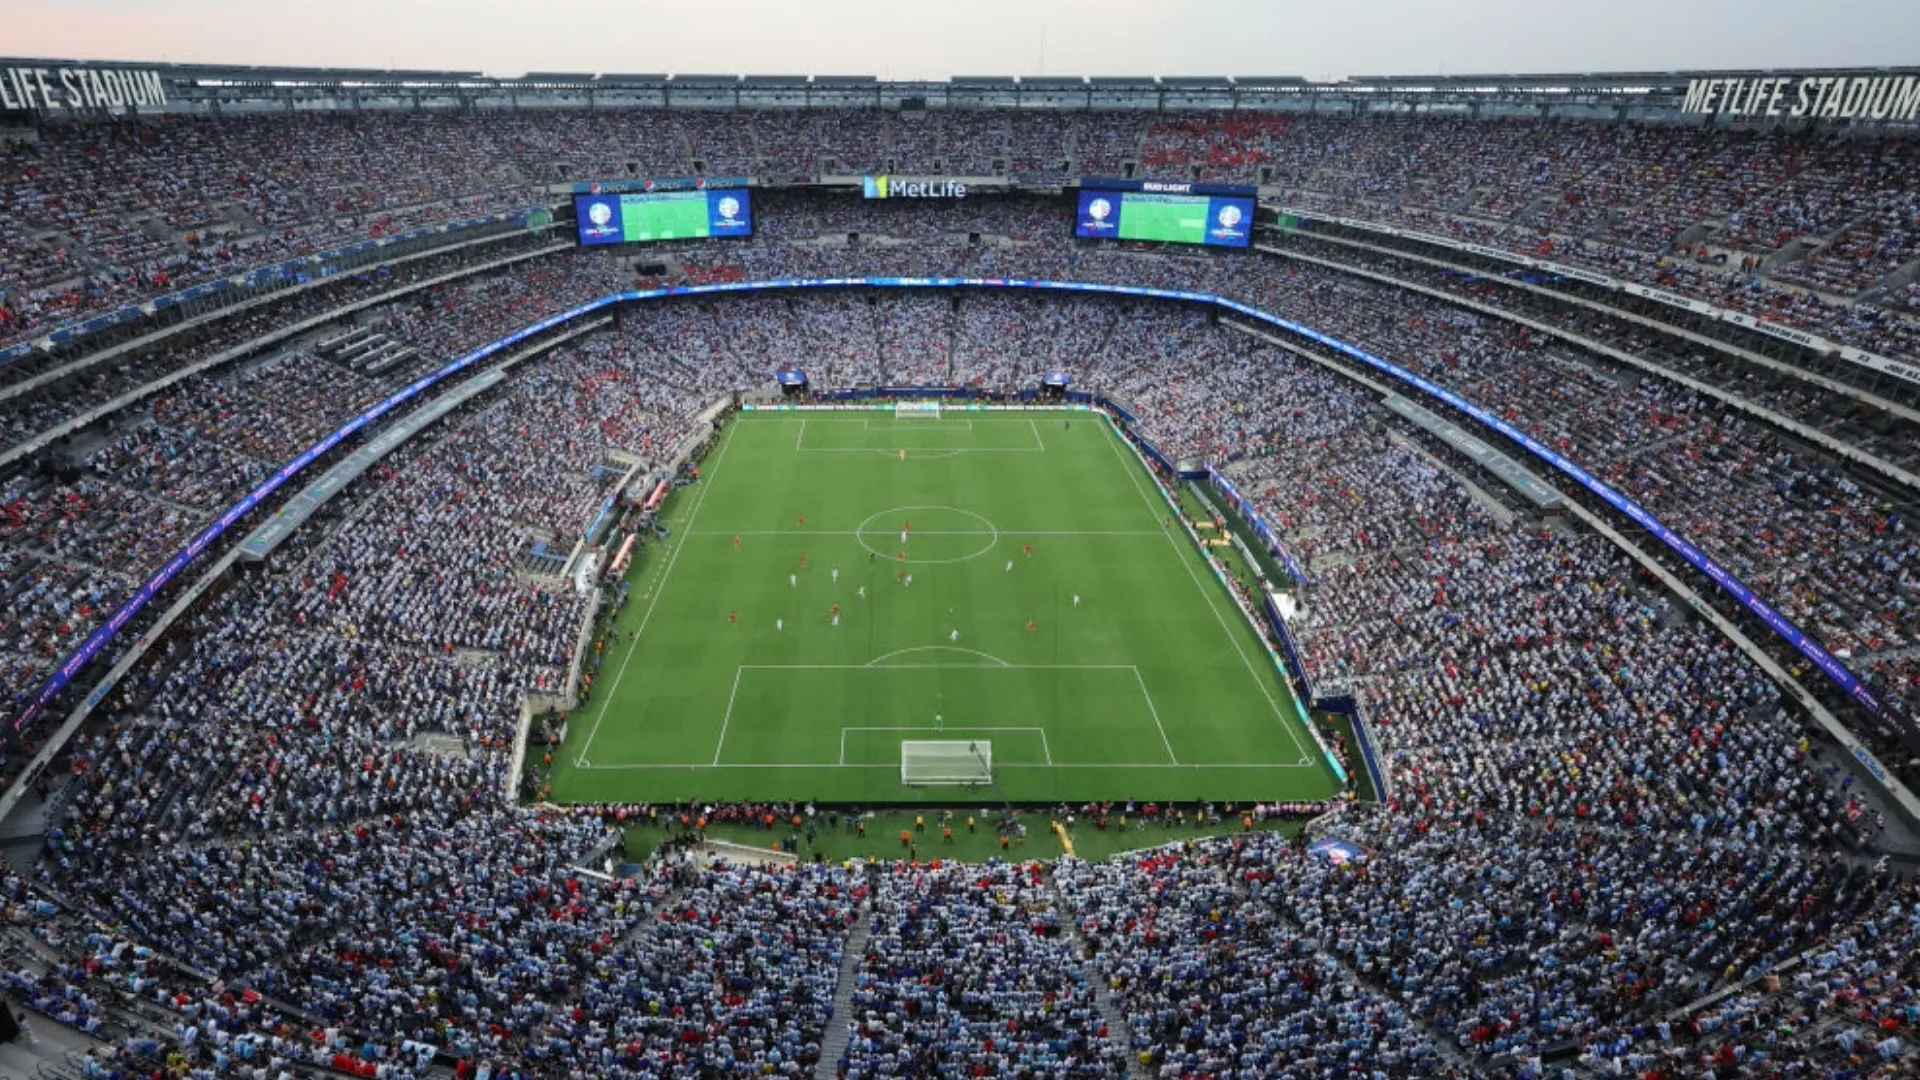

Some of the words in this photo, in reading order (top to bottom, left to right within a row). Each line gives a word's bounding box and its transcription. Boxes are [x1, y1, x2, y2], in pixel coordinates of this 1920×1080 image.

[0, 68, 60, 109] LIFE
[59, 68, 167, 108] STADIUM
[1681, 78, 1790, 116] METLIFE
[1790, 77, 1920, 120] STADIUM
[889, 180, 967, 198] MetLife
